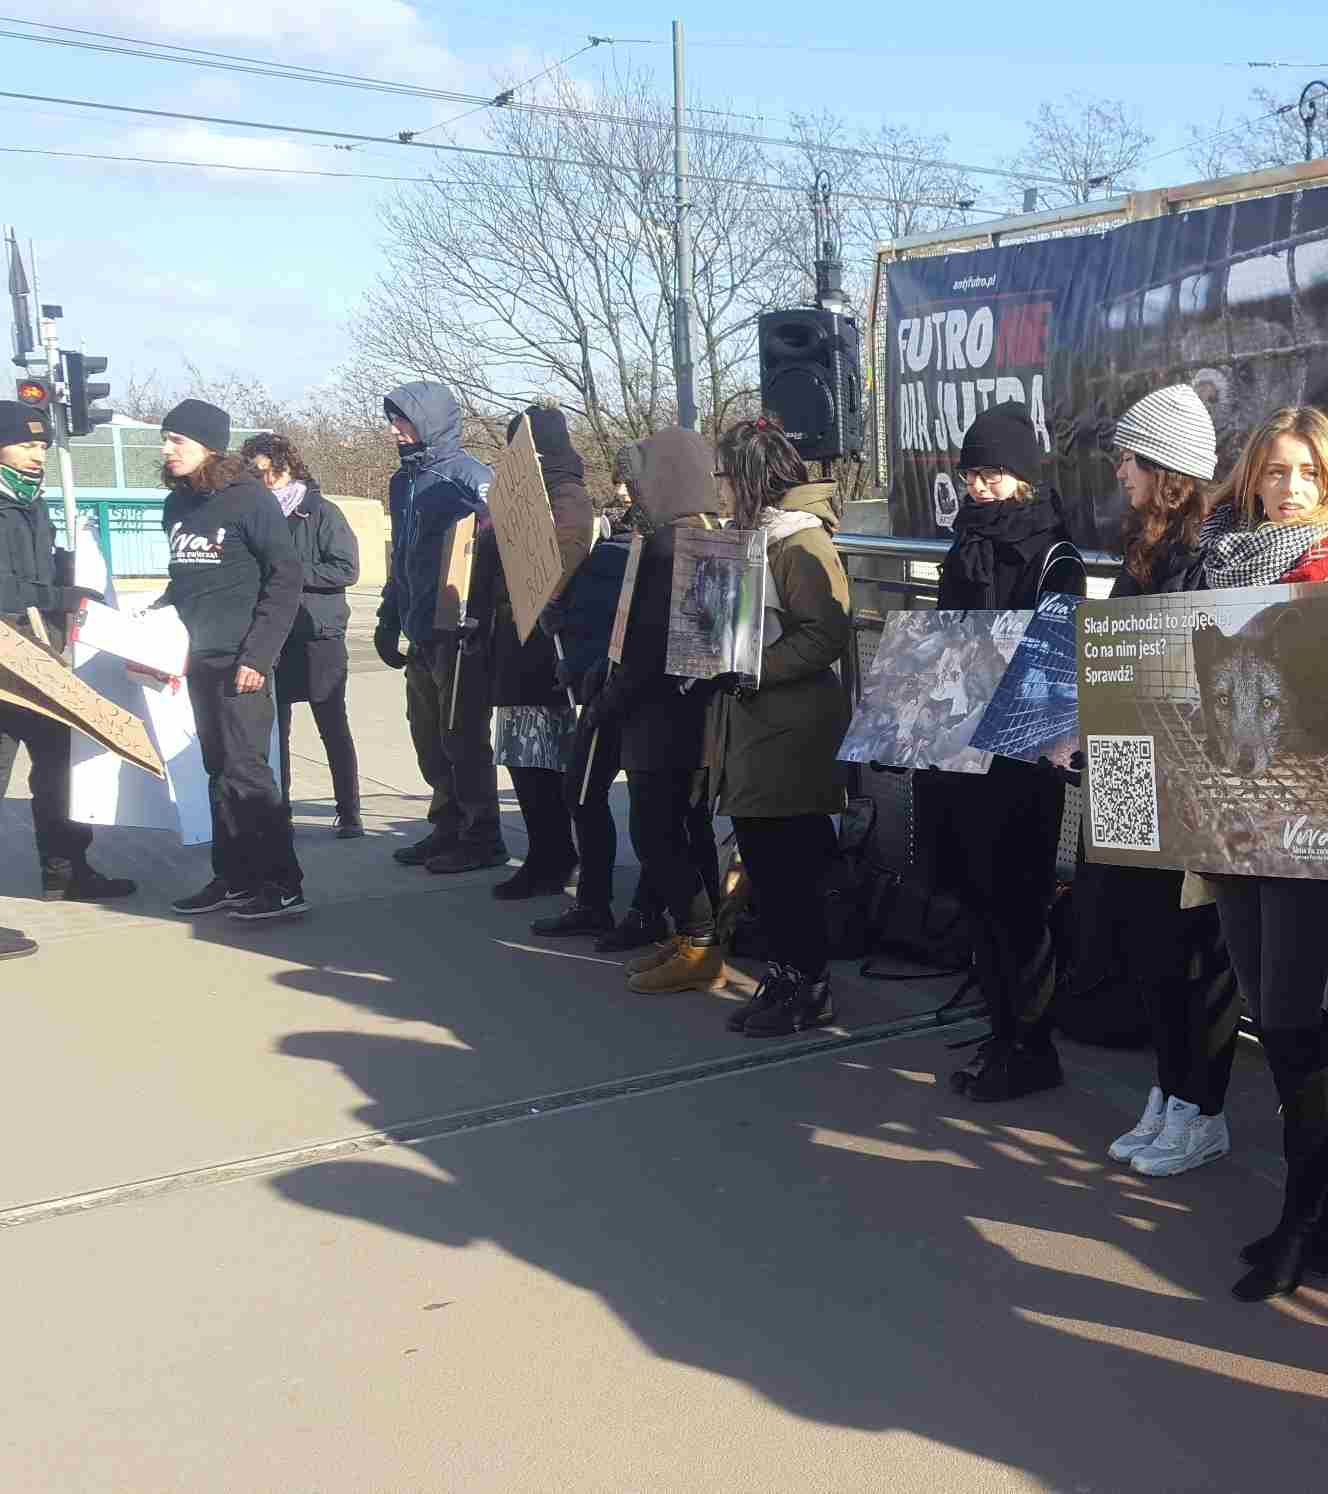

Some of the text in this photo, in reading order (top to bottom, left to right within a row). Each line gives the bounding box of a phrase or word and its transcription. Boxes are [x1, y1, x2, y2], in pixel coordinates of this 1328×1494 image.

[898, 306, 994, 374] FUTRO
[1084, 615, 1109, 636] Skąd
[1111, 612, 1163, 635] pochodzi
[1166, 612, 1178, 629] to
[1084, 642, 1099, 659] Co
[1100, 646, 1114, 657] na
[1116, 639, 1137, 657] nim
[1138, 638, 1167, 660] jest?
[1085, 664, 1134, 686] Sprawdź!
